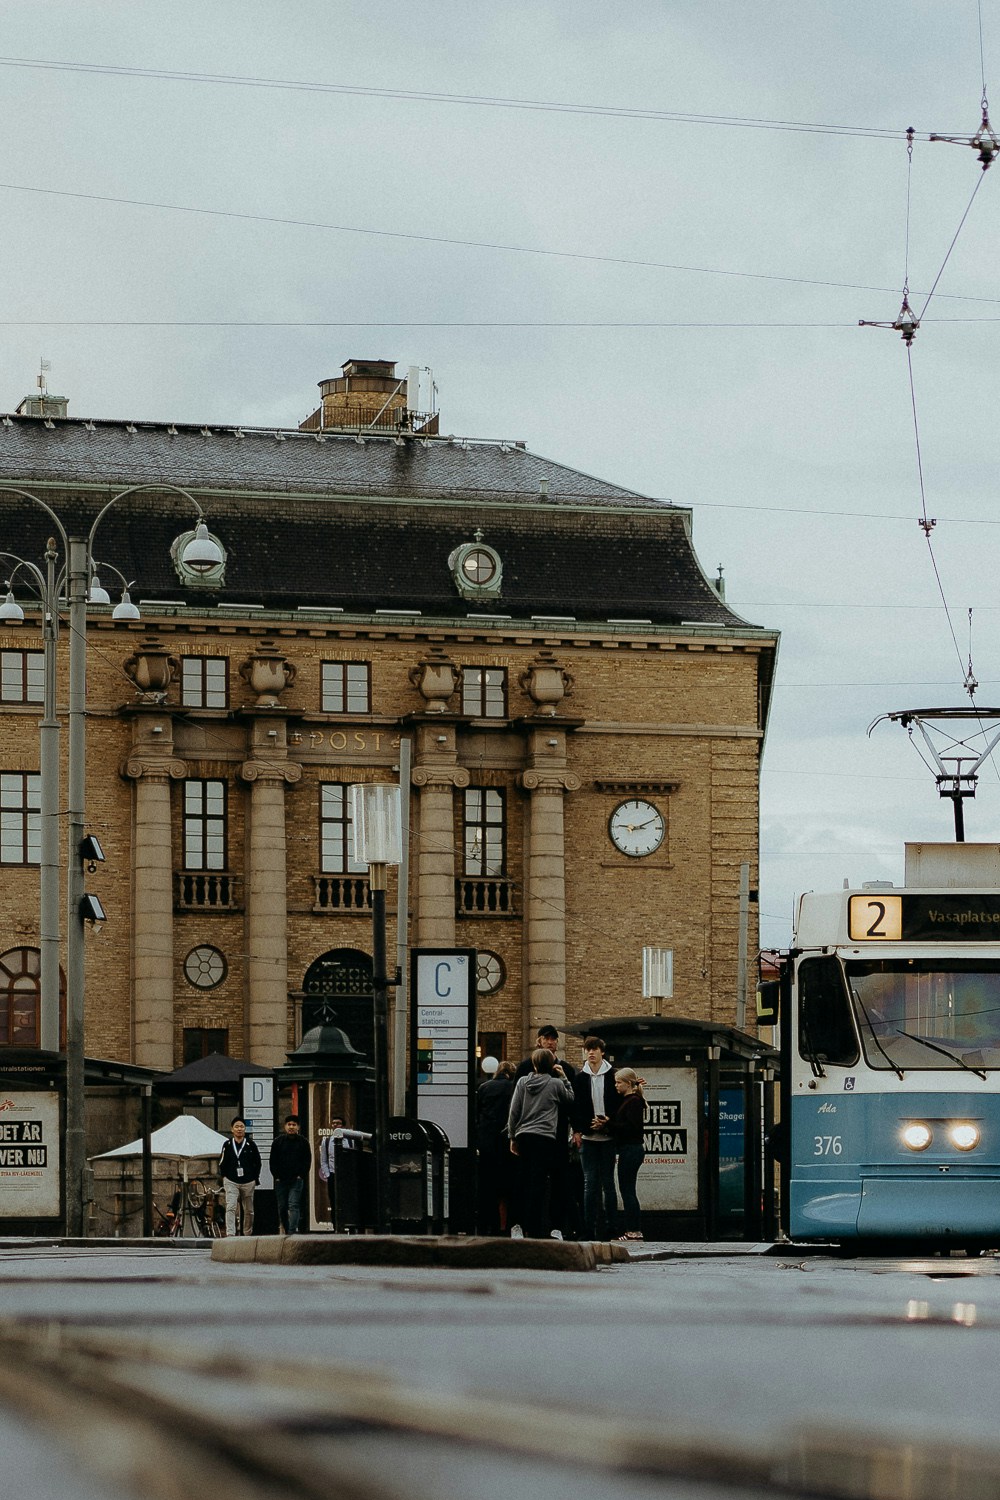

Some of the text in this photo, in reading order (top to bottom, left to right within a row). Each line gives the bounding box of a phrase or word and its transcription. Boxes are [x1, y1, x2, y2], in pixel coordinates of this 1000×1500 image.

[310, 730, 385, 751] POST
[866, 901, 887, 937] 2
[435, 962, 451, 997] C
[427, 1063, 432, 1071] 7
[253, 1082, 264, 1102] D
[817, 1102, 838, 1114] Ada
[22, 1122, 41, 1141] ÄR
[642, 1130, 684, 1152] NÄRA
[813, 1135, 843, 1156] 376
[27, 1149, 45, 1165] NU
